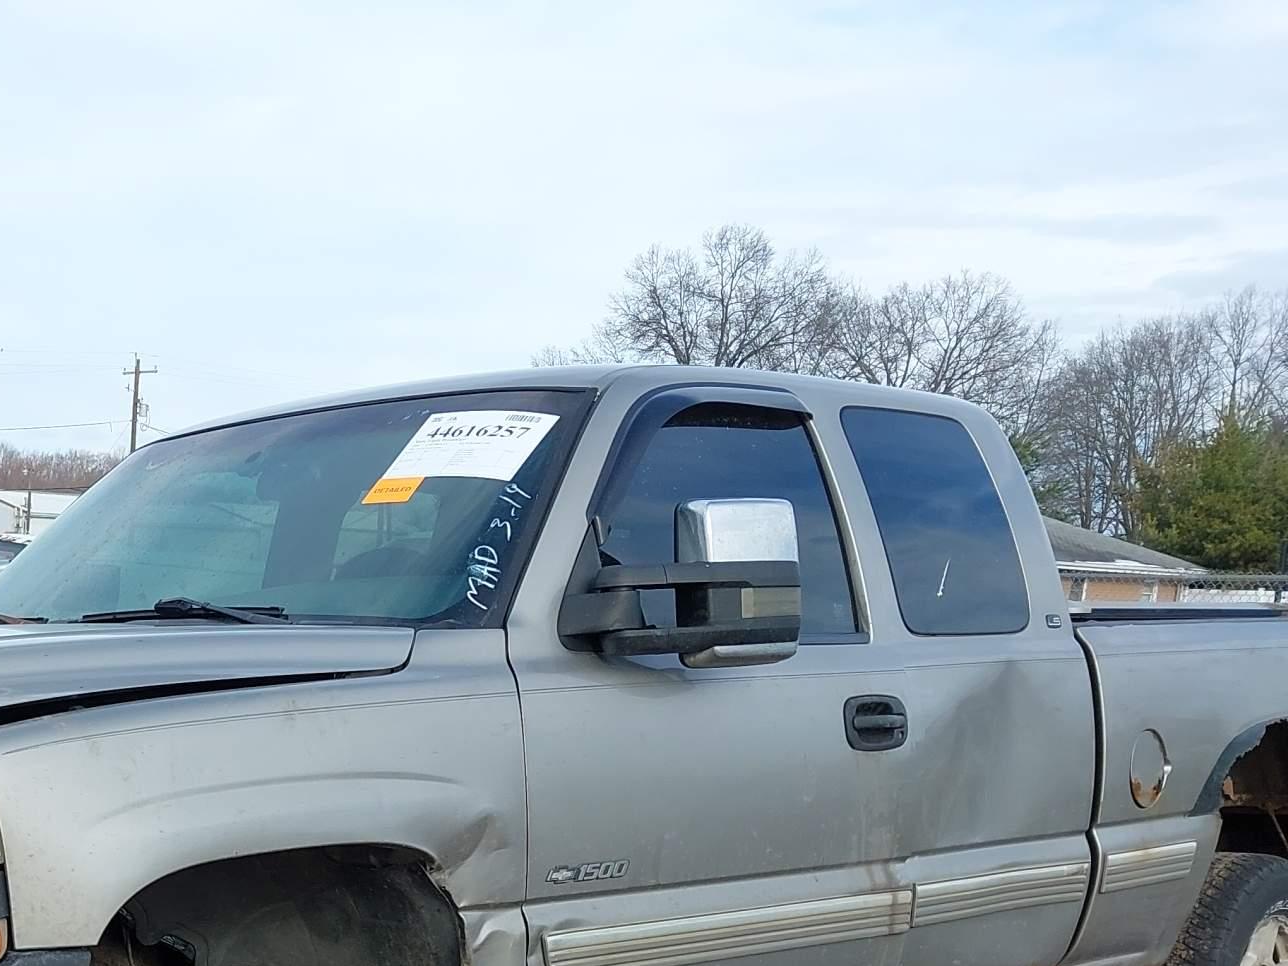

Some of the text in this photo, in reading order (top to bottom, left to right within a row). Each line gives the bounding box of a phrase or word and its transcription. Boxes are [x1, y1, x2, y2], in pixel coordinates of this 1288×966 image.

[426, 424, 533, 439] 44616257
[373, 486, 412, 495] DETAILED
[465, 544, 502, 610] MAD
[577, 859, 629, 881] 1500
